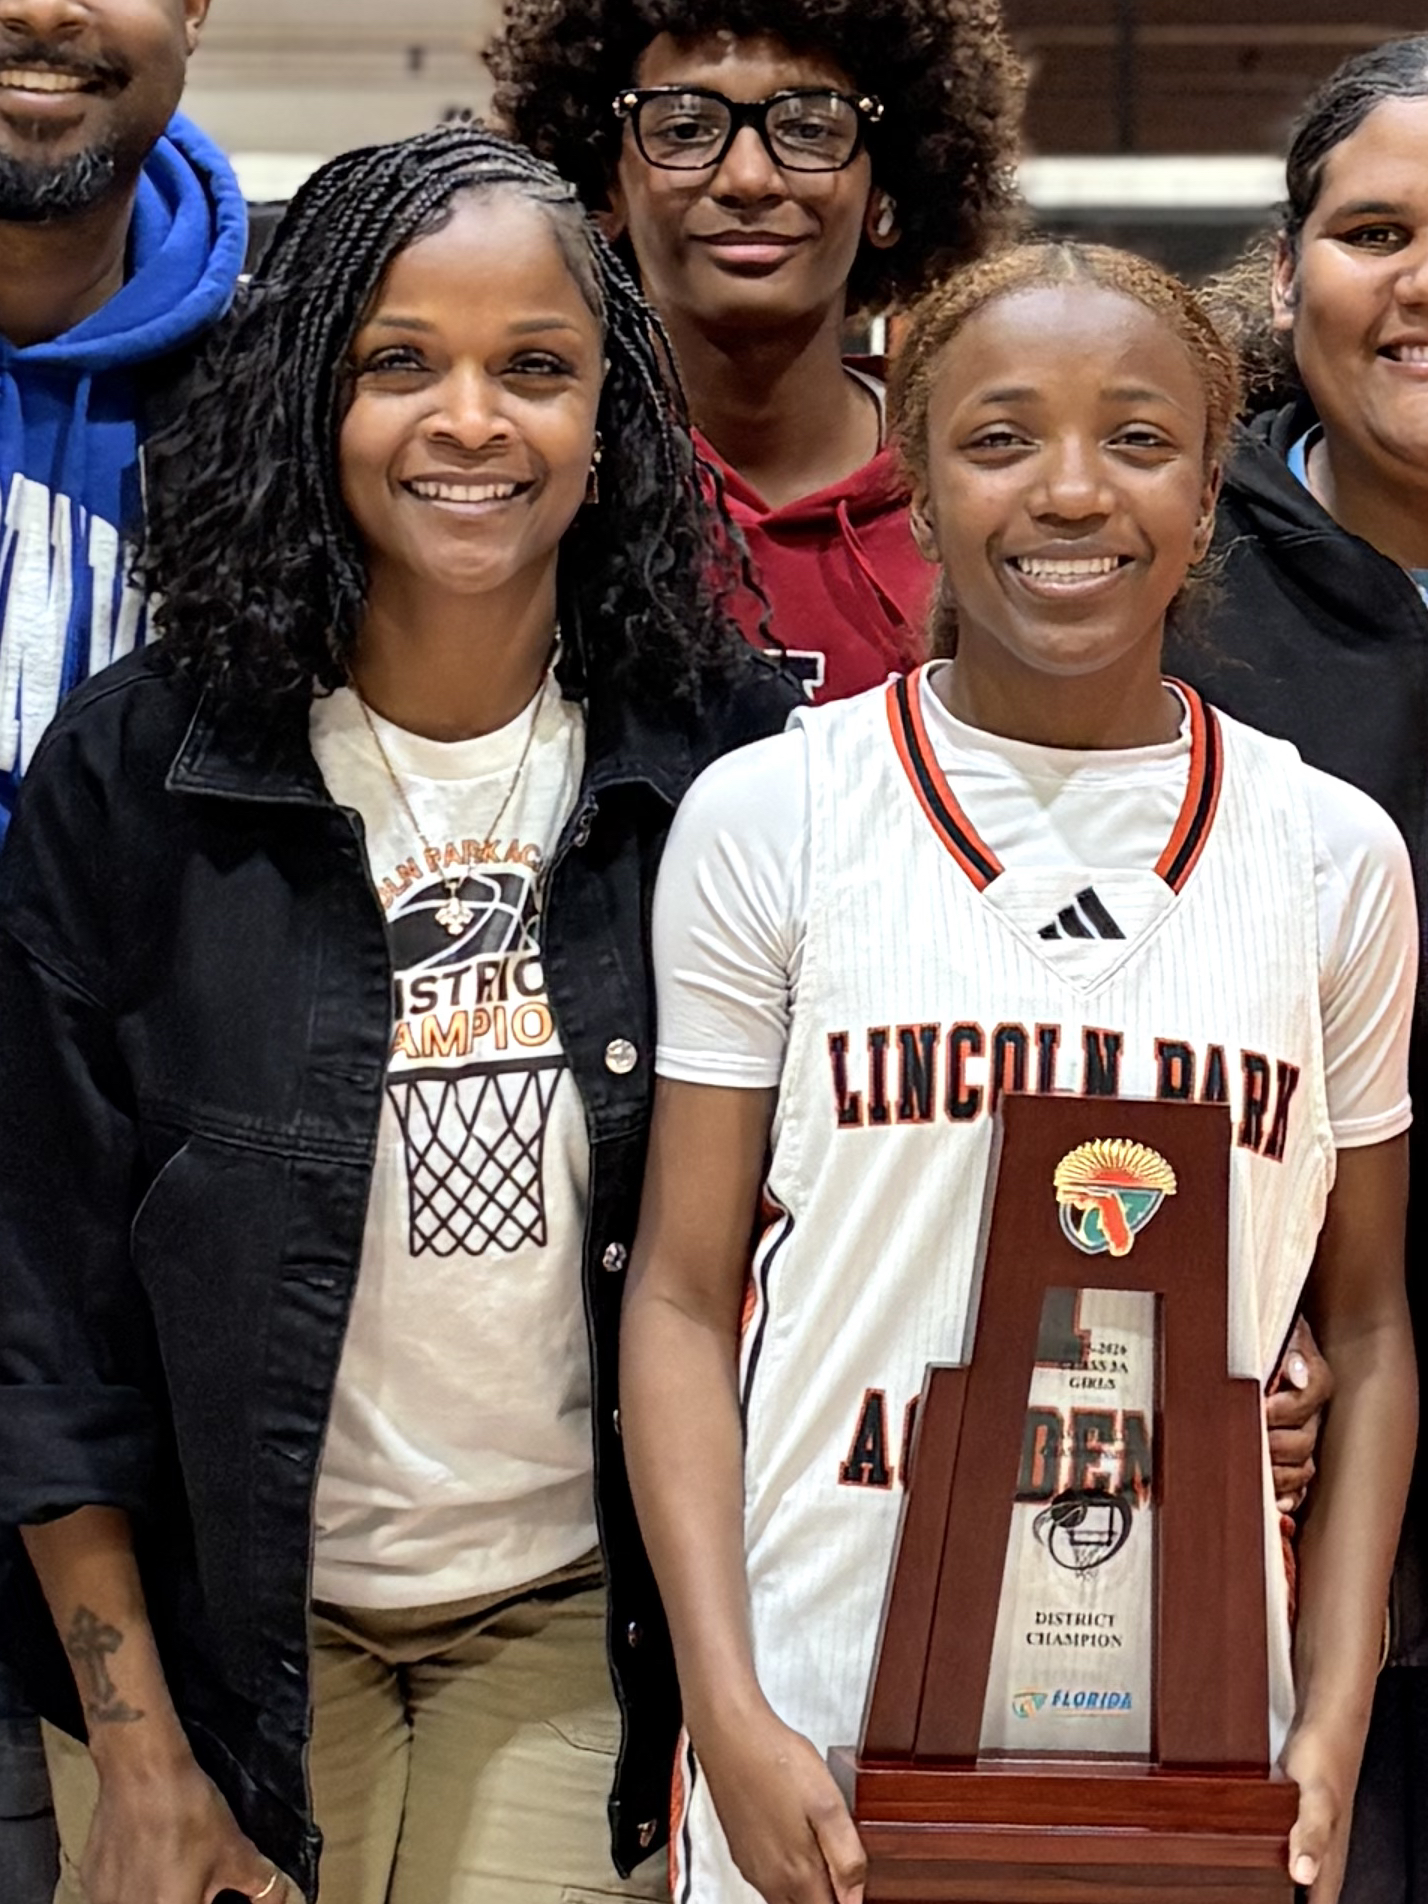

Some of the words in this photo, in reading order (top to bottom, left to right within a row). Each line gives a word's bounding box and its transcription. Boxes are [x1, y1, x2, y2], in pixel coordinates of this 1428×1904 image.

[424, 840, 501, 872] PARK
[1069, 1377, 1116, 1389] GIRLS
[1036, 1612, 1114, 1627] DISTRICT
[1026, 1632, 1122, 1647] CHAMPION
[1052, 1689, 1132, 1709] FLORIDA
